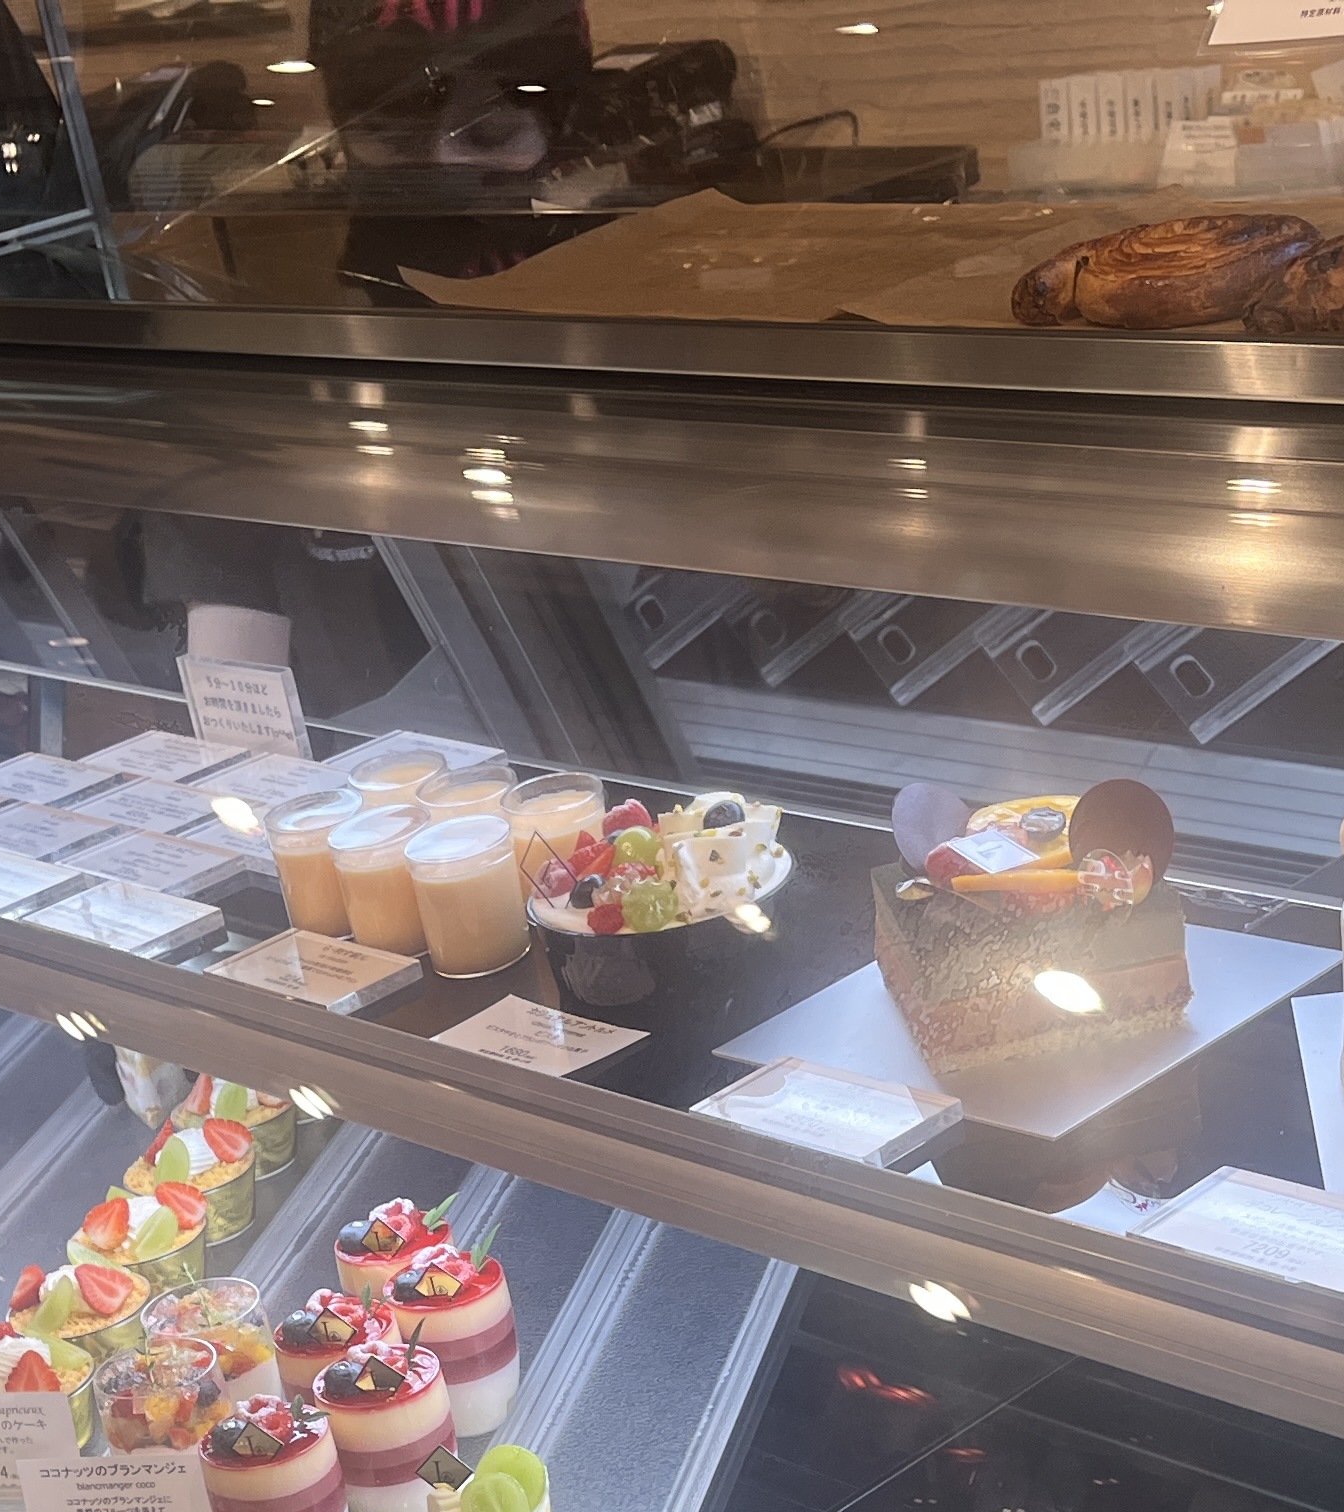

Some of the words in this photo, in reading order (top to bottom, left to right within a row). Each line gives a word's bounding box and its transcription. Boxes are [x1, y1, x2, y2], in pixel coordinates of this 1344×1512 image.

[39, 1461, 187, 1478] ココナッツのブランマンジェ
